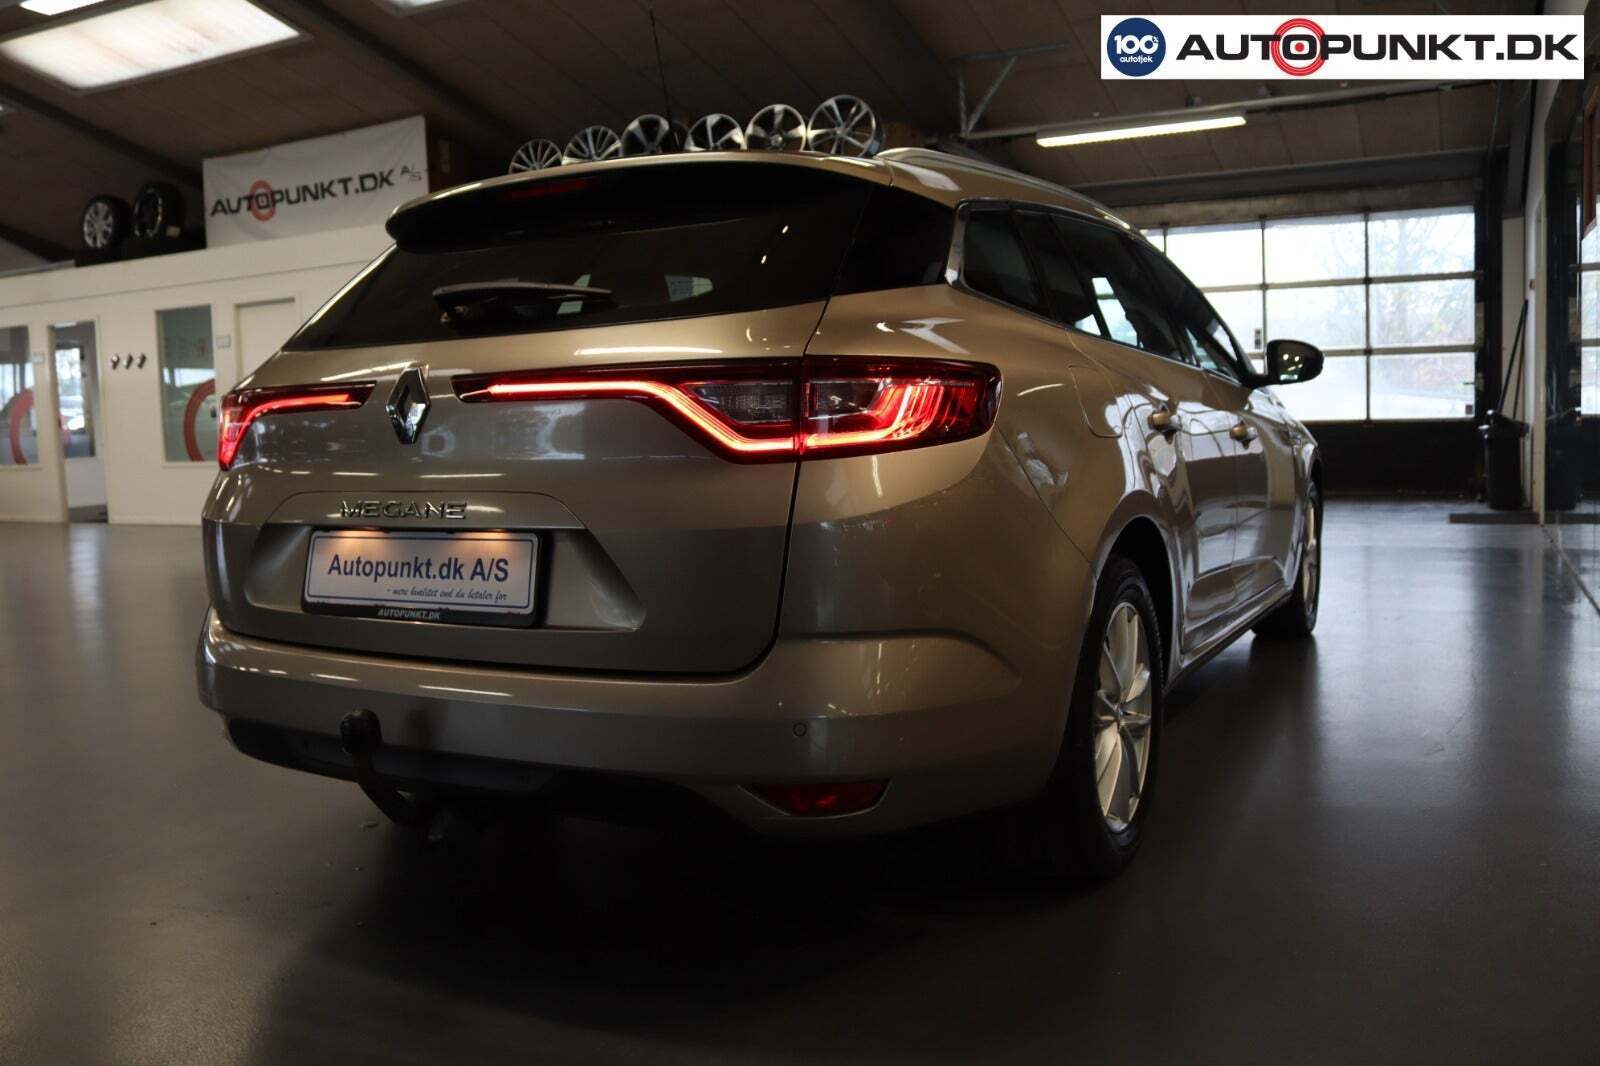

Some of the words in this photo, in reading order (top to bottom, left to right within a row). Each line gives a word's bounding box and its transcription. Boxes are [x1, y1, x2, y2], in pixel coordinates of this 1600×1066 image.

[211, 168, 394, 217] AUTOPUNKT.DK
[340, 500, 468, 520] MEGANE
[328, 554, 465, 583] Autopunkt.dk
[470, 558, 510, 583] A/S
[377, 607, 441, 620] AUTOPUNKT.DK
